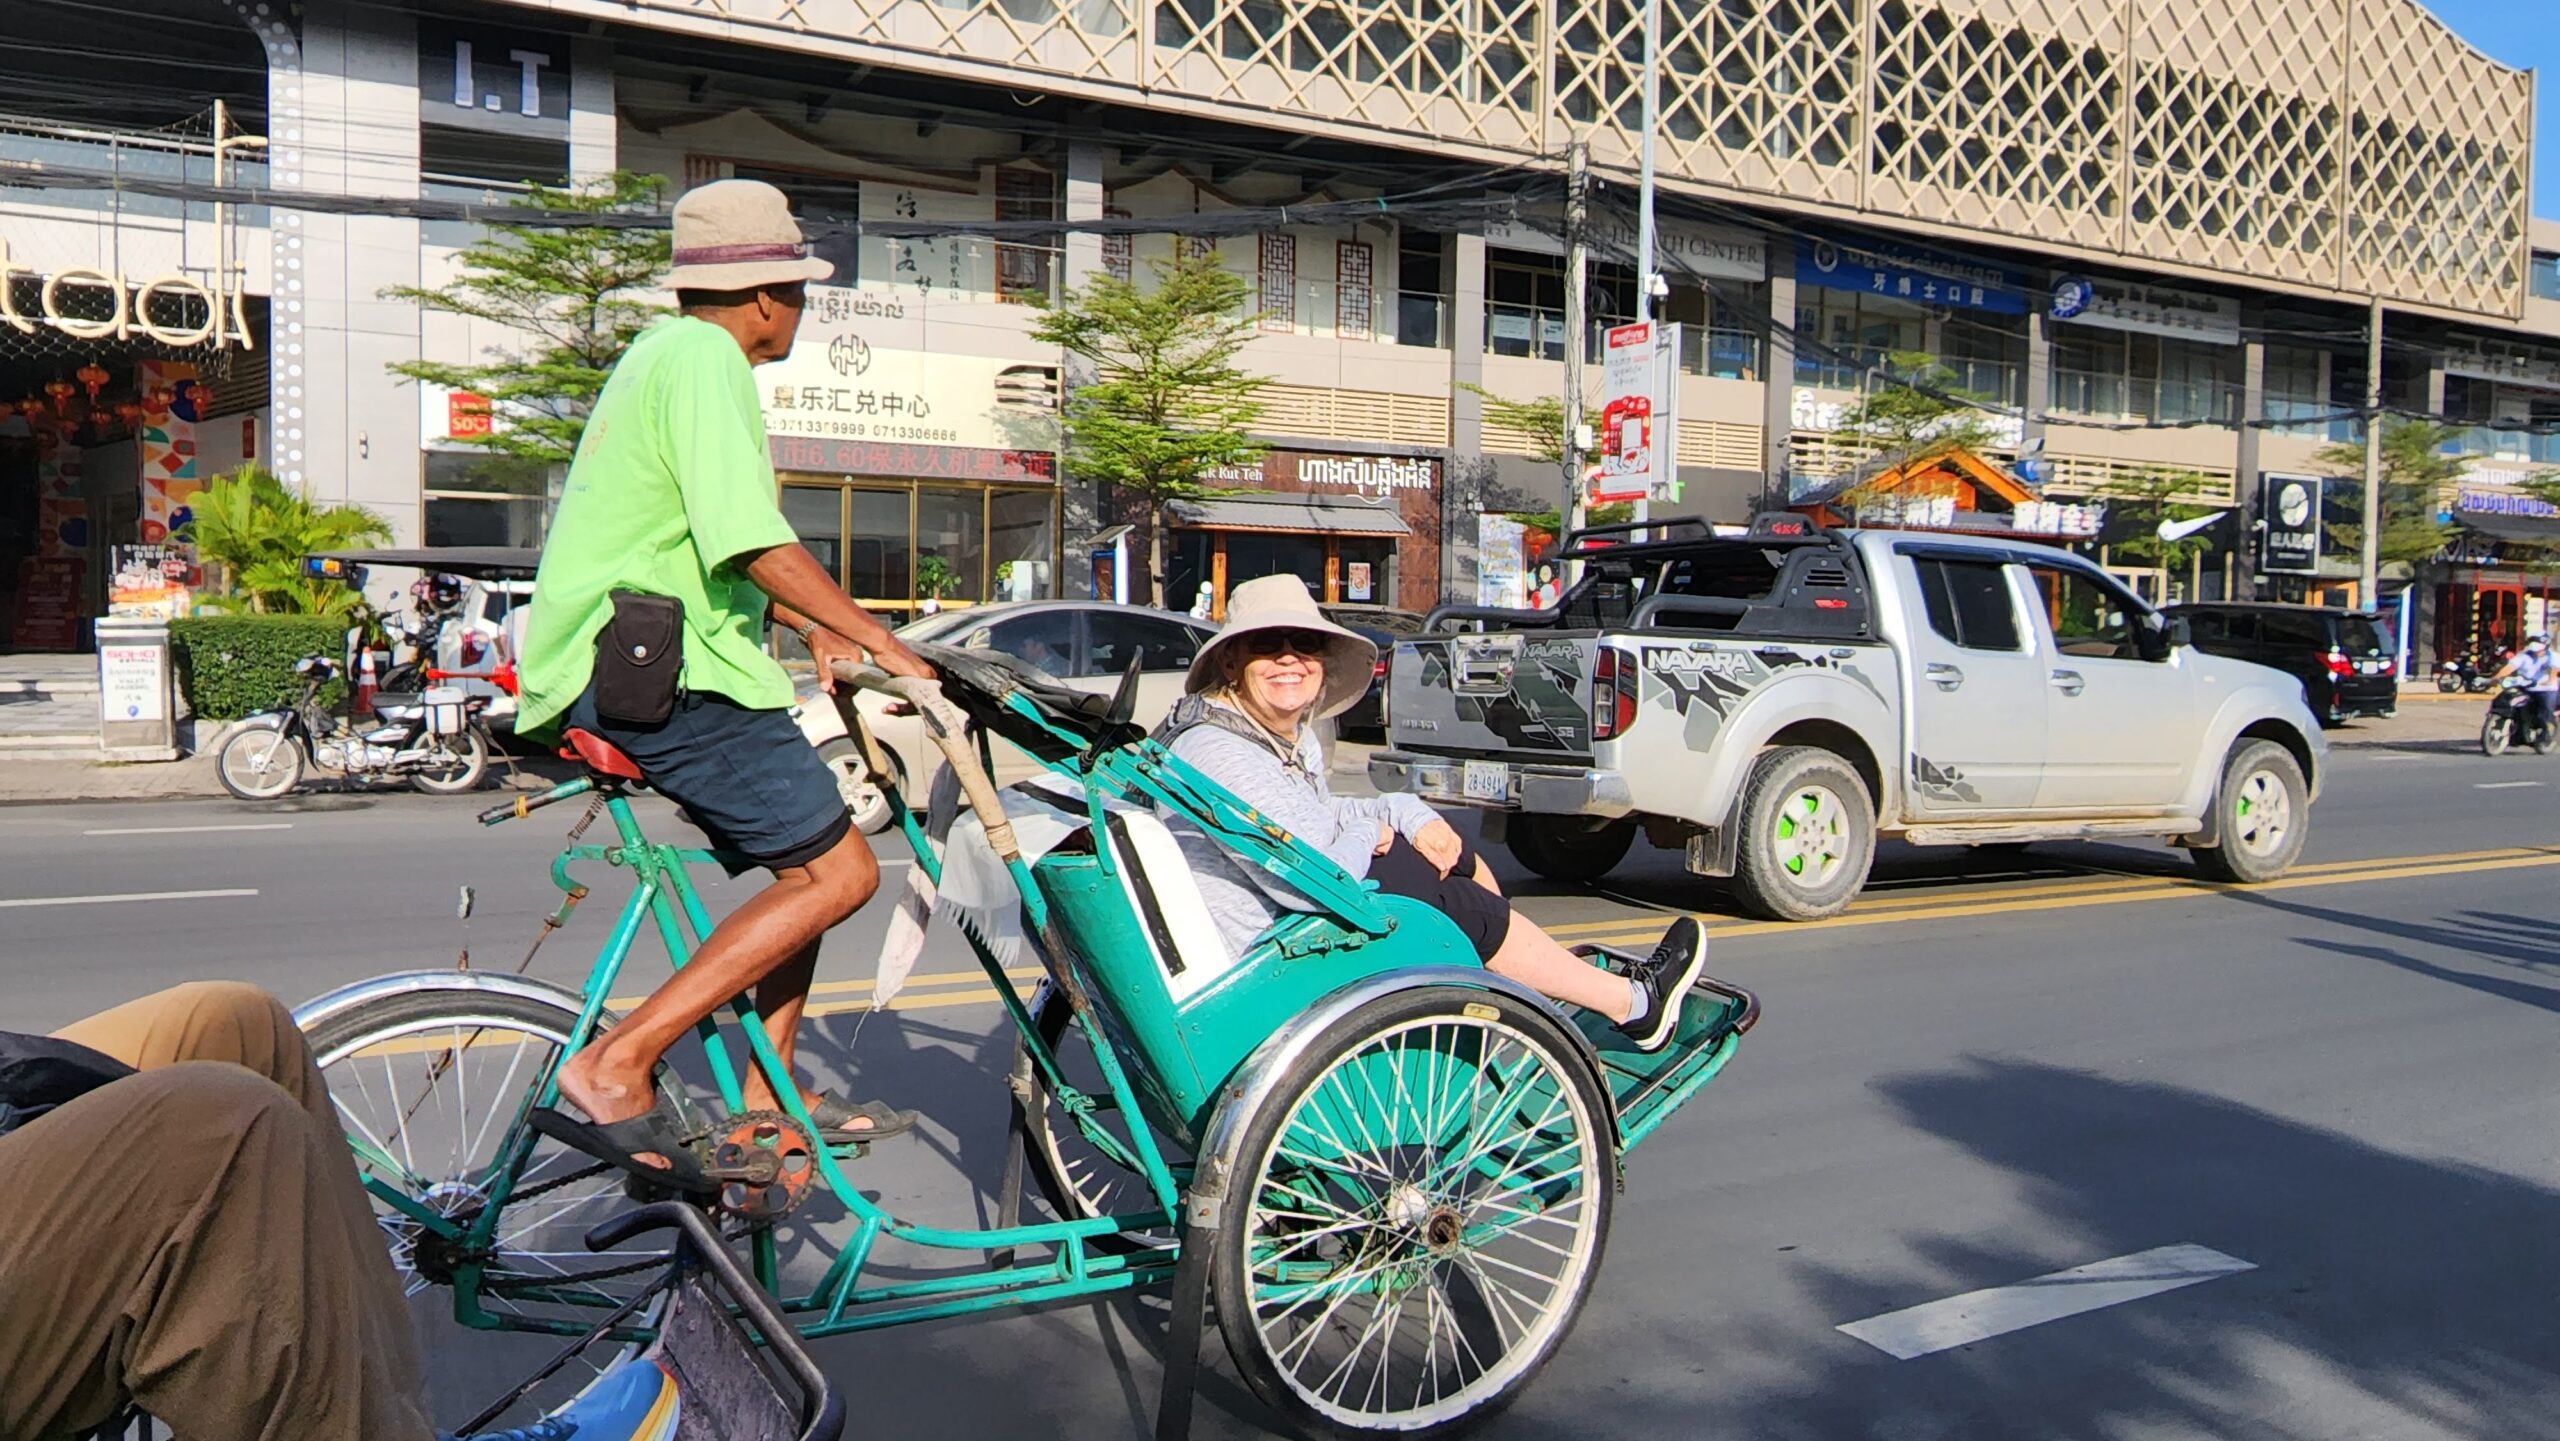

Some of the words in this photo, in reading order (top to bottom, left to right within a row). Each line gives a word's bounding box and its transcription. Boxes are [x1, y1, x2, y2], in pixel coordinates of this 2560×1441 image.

[1689, 236, 1760, 263] CENTER
[1218, 466, 1240, 480] Kut
[1241, 468, 1264, 482] Teh
[1523, 643, 1583, 660] NAVARA
[1648, 649, 1754, 675] NAVARA
